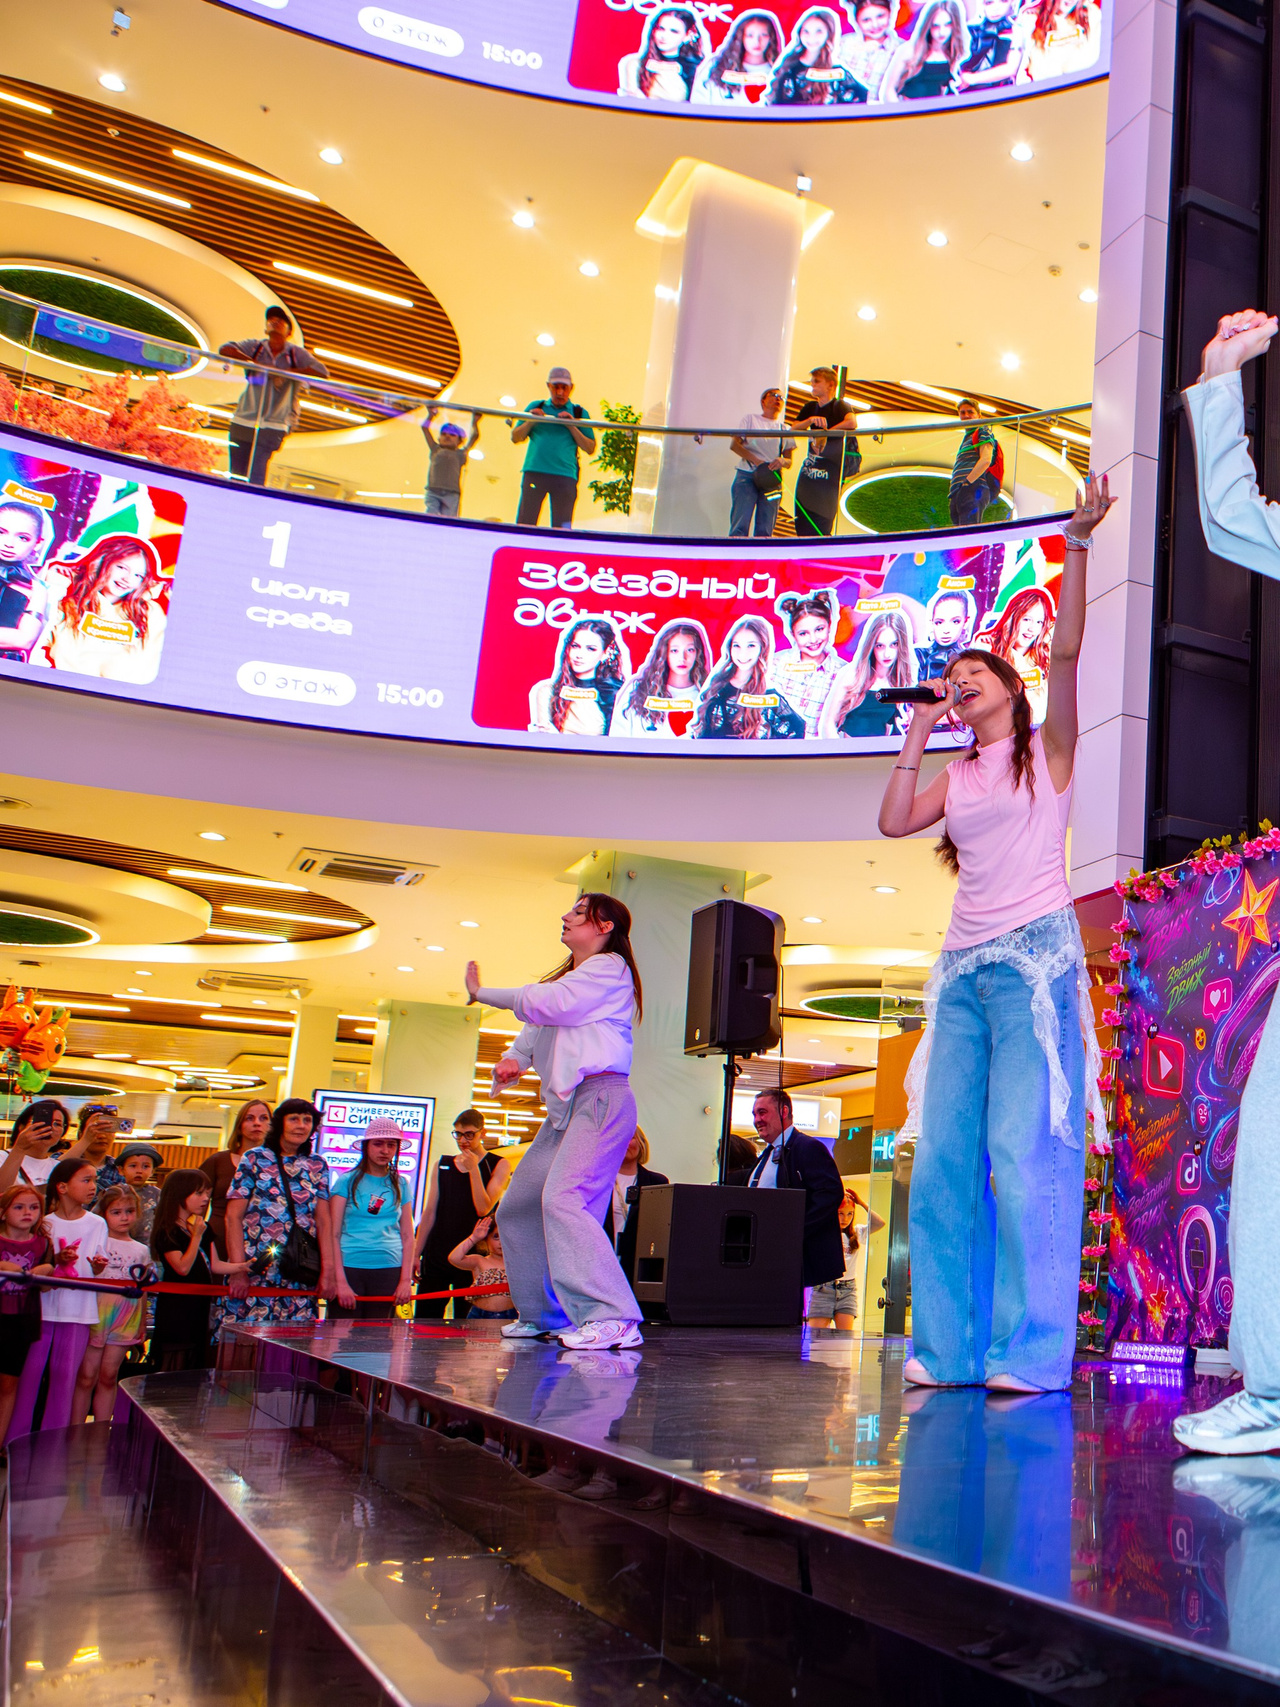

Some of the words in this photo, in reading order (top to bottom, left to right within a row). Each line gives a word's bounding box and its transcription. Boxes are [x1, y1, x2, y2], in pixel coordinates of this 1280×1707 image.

[481, 41, 543, 70] 15:00
[262, 521, 291, 568] 1
[251, 577, 350, 607] июля
[246, 606, 353, 636] среда
[275, 677, 339, 697] этаж
[376, 683, 444, 709] 15:00
[350, 1106, 420, 1118] УНИВЕРСИТЕТ
